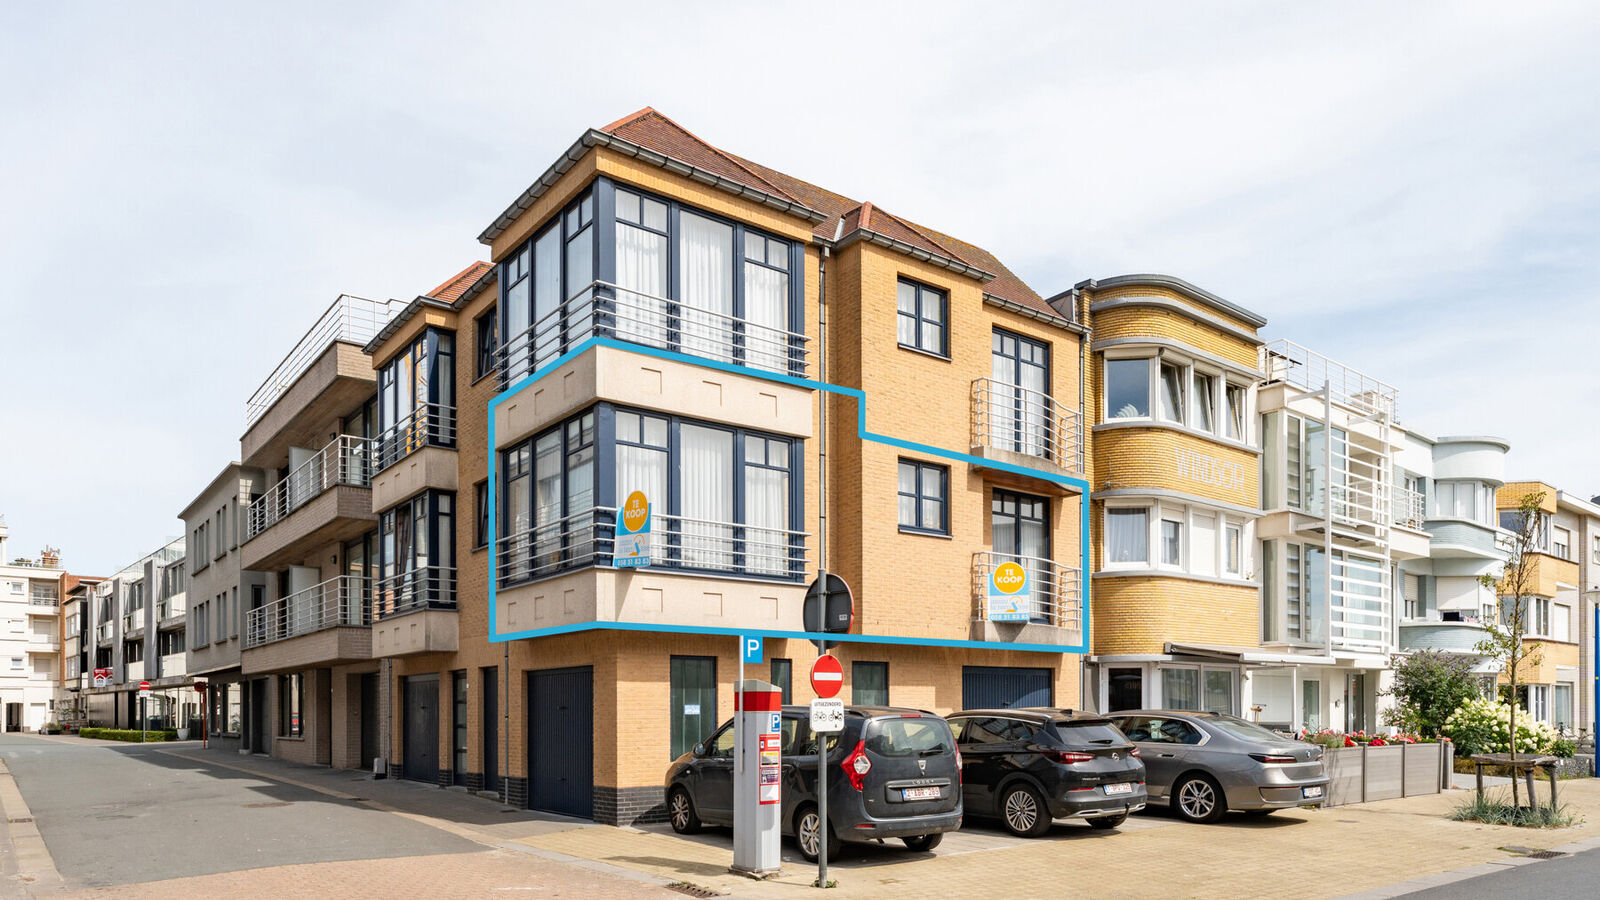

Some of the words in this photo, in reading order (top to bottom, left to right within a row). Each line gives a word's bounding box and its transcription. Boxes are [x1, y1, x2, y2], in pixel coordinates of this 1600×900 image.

[1174, 446, 1248, 500] WINDSOR
[632, 499, 640, 508] TE
[625, 508, 646, 520] KOOP
[1004, 568, 1014, 576] TE
[996, 576, 1023, 584] KOOP
[747, 639, 760, 658] P
[772, 714, 780, 728] P
